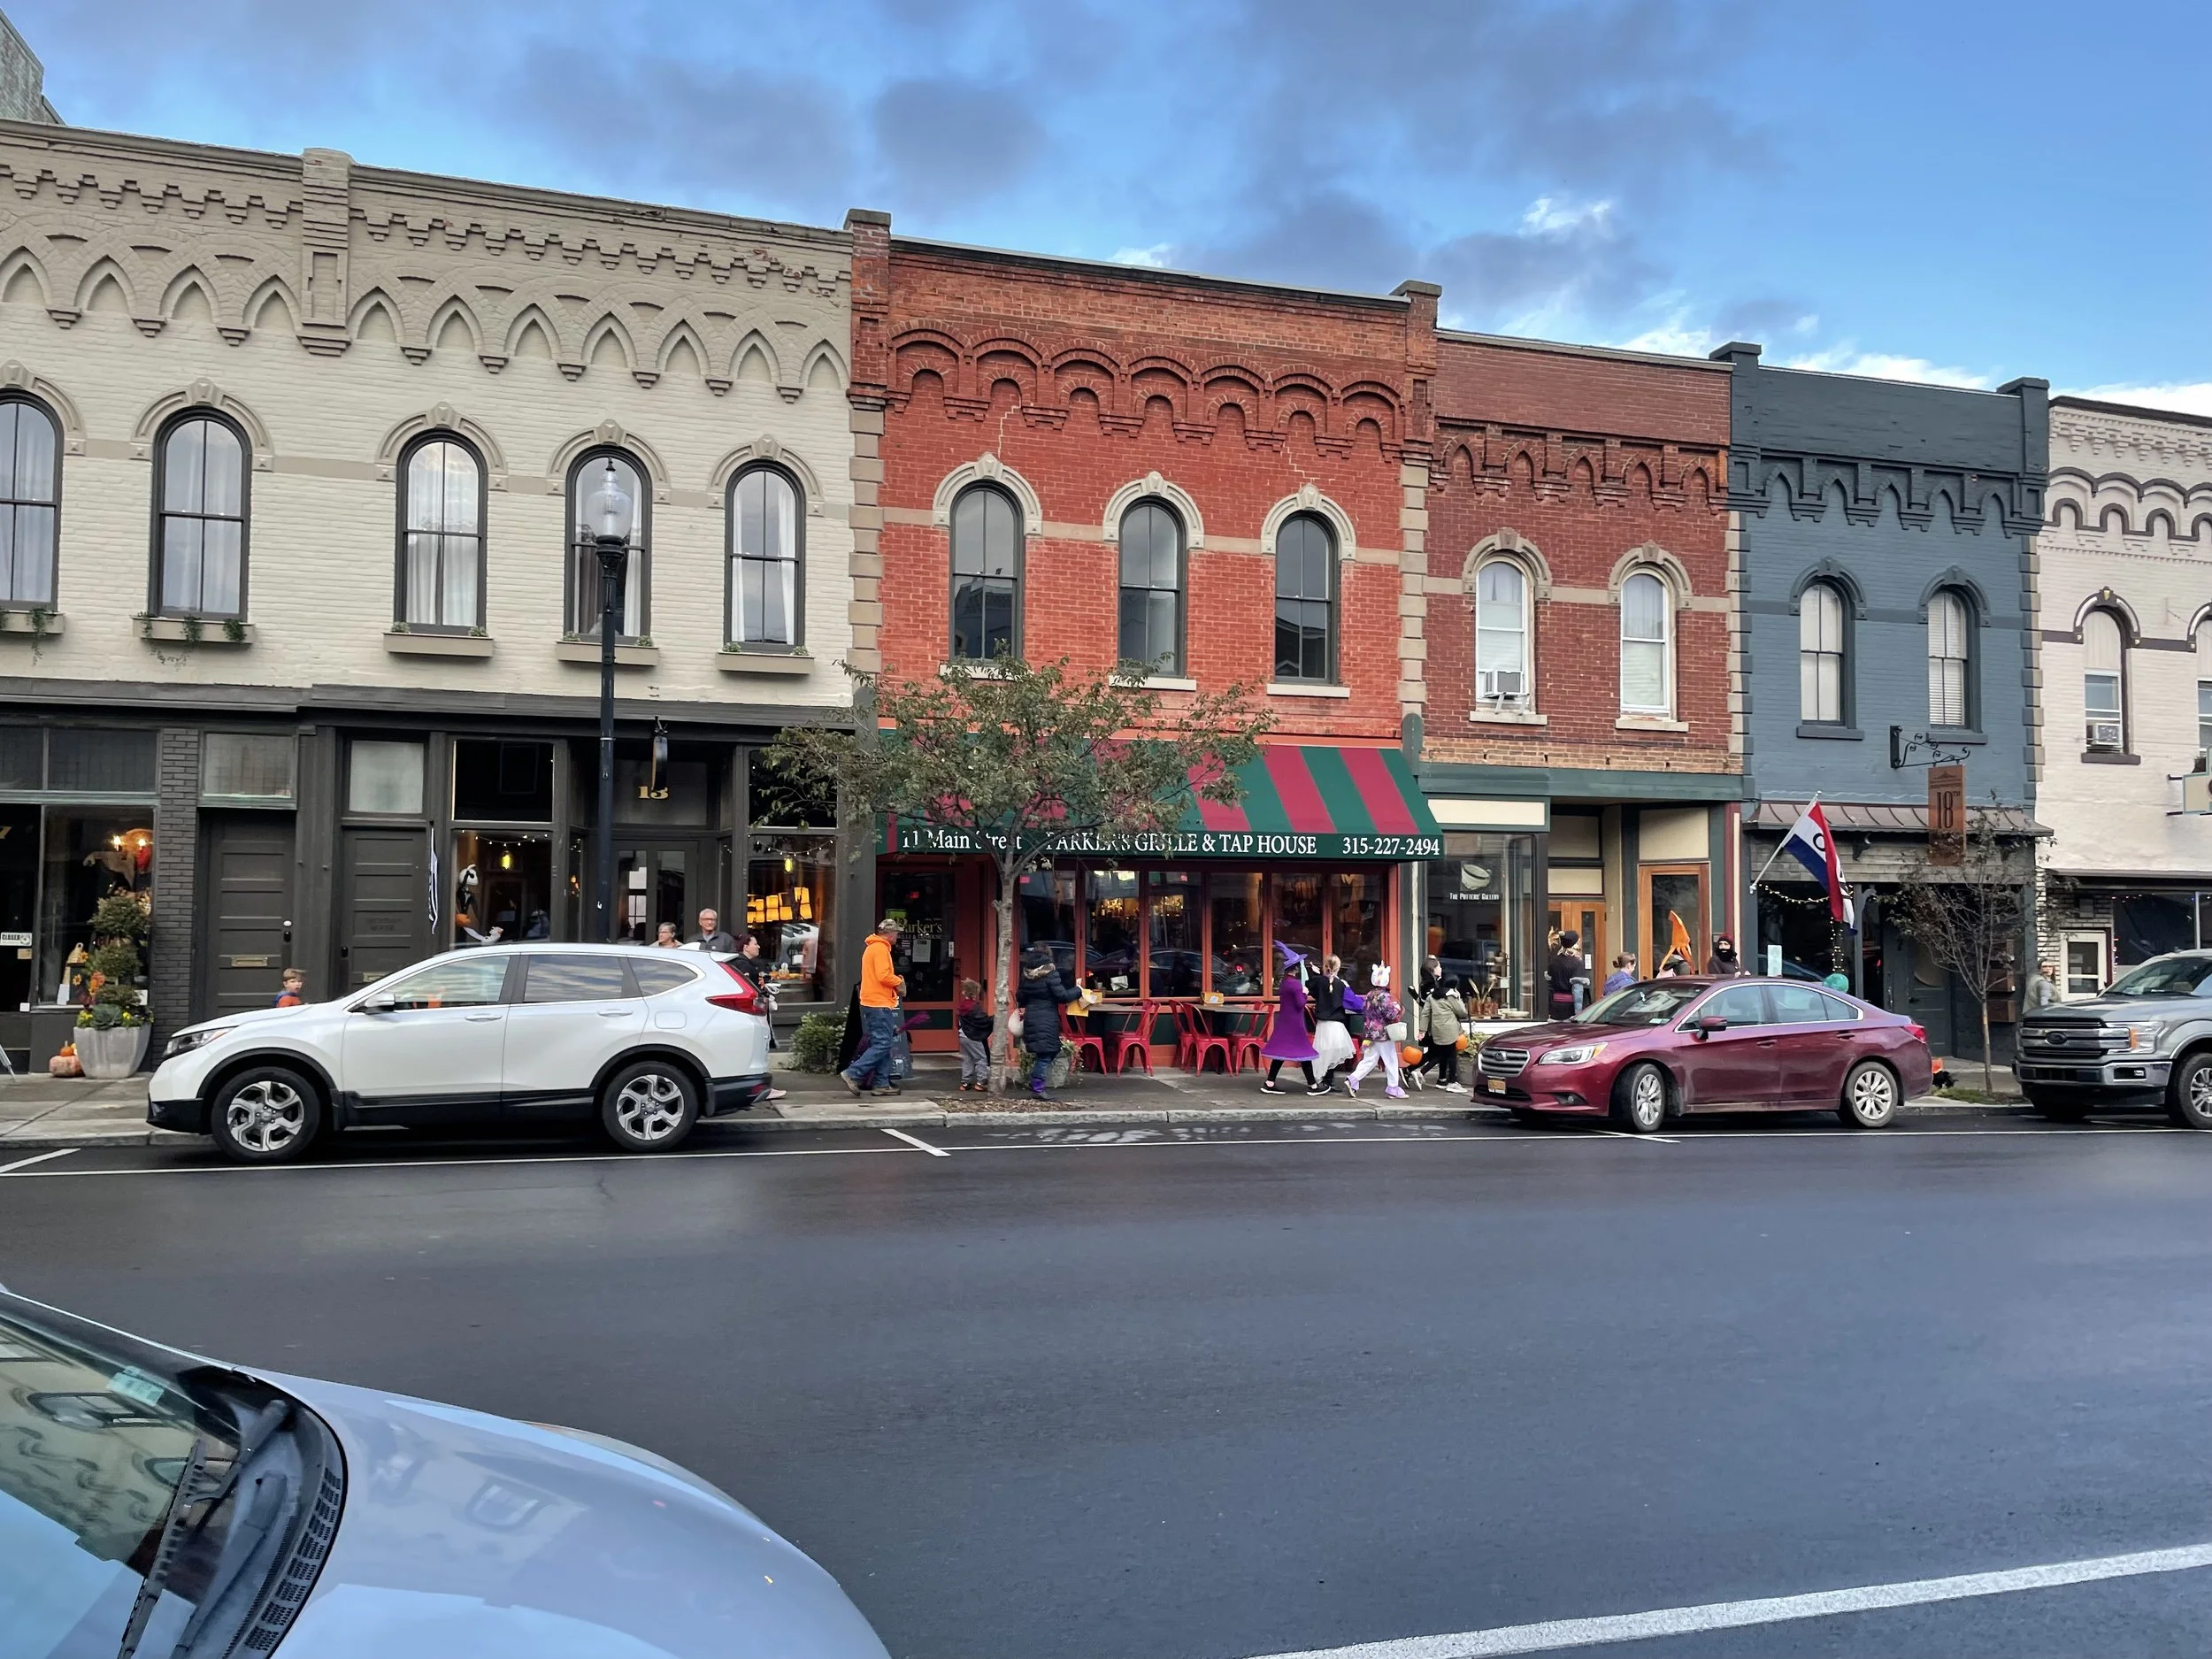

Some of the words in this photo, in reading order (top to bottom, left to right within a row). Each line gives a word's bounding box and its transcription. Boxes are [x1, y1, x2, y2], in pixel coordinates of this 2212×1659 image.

[926, 830, 970, 849] Main
[975, 831, 1022, 849] Sret
[1202, 834, 1216, 852] &
[1219, 834, 1253, 853] TAP
[1257, 835, 1317, 855] HOUSE
[1342, 837, 1440, 856] 315-227-2494
